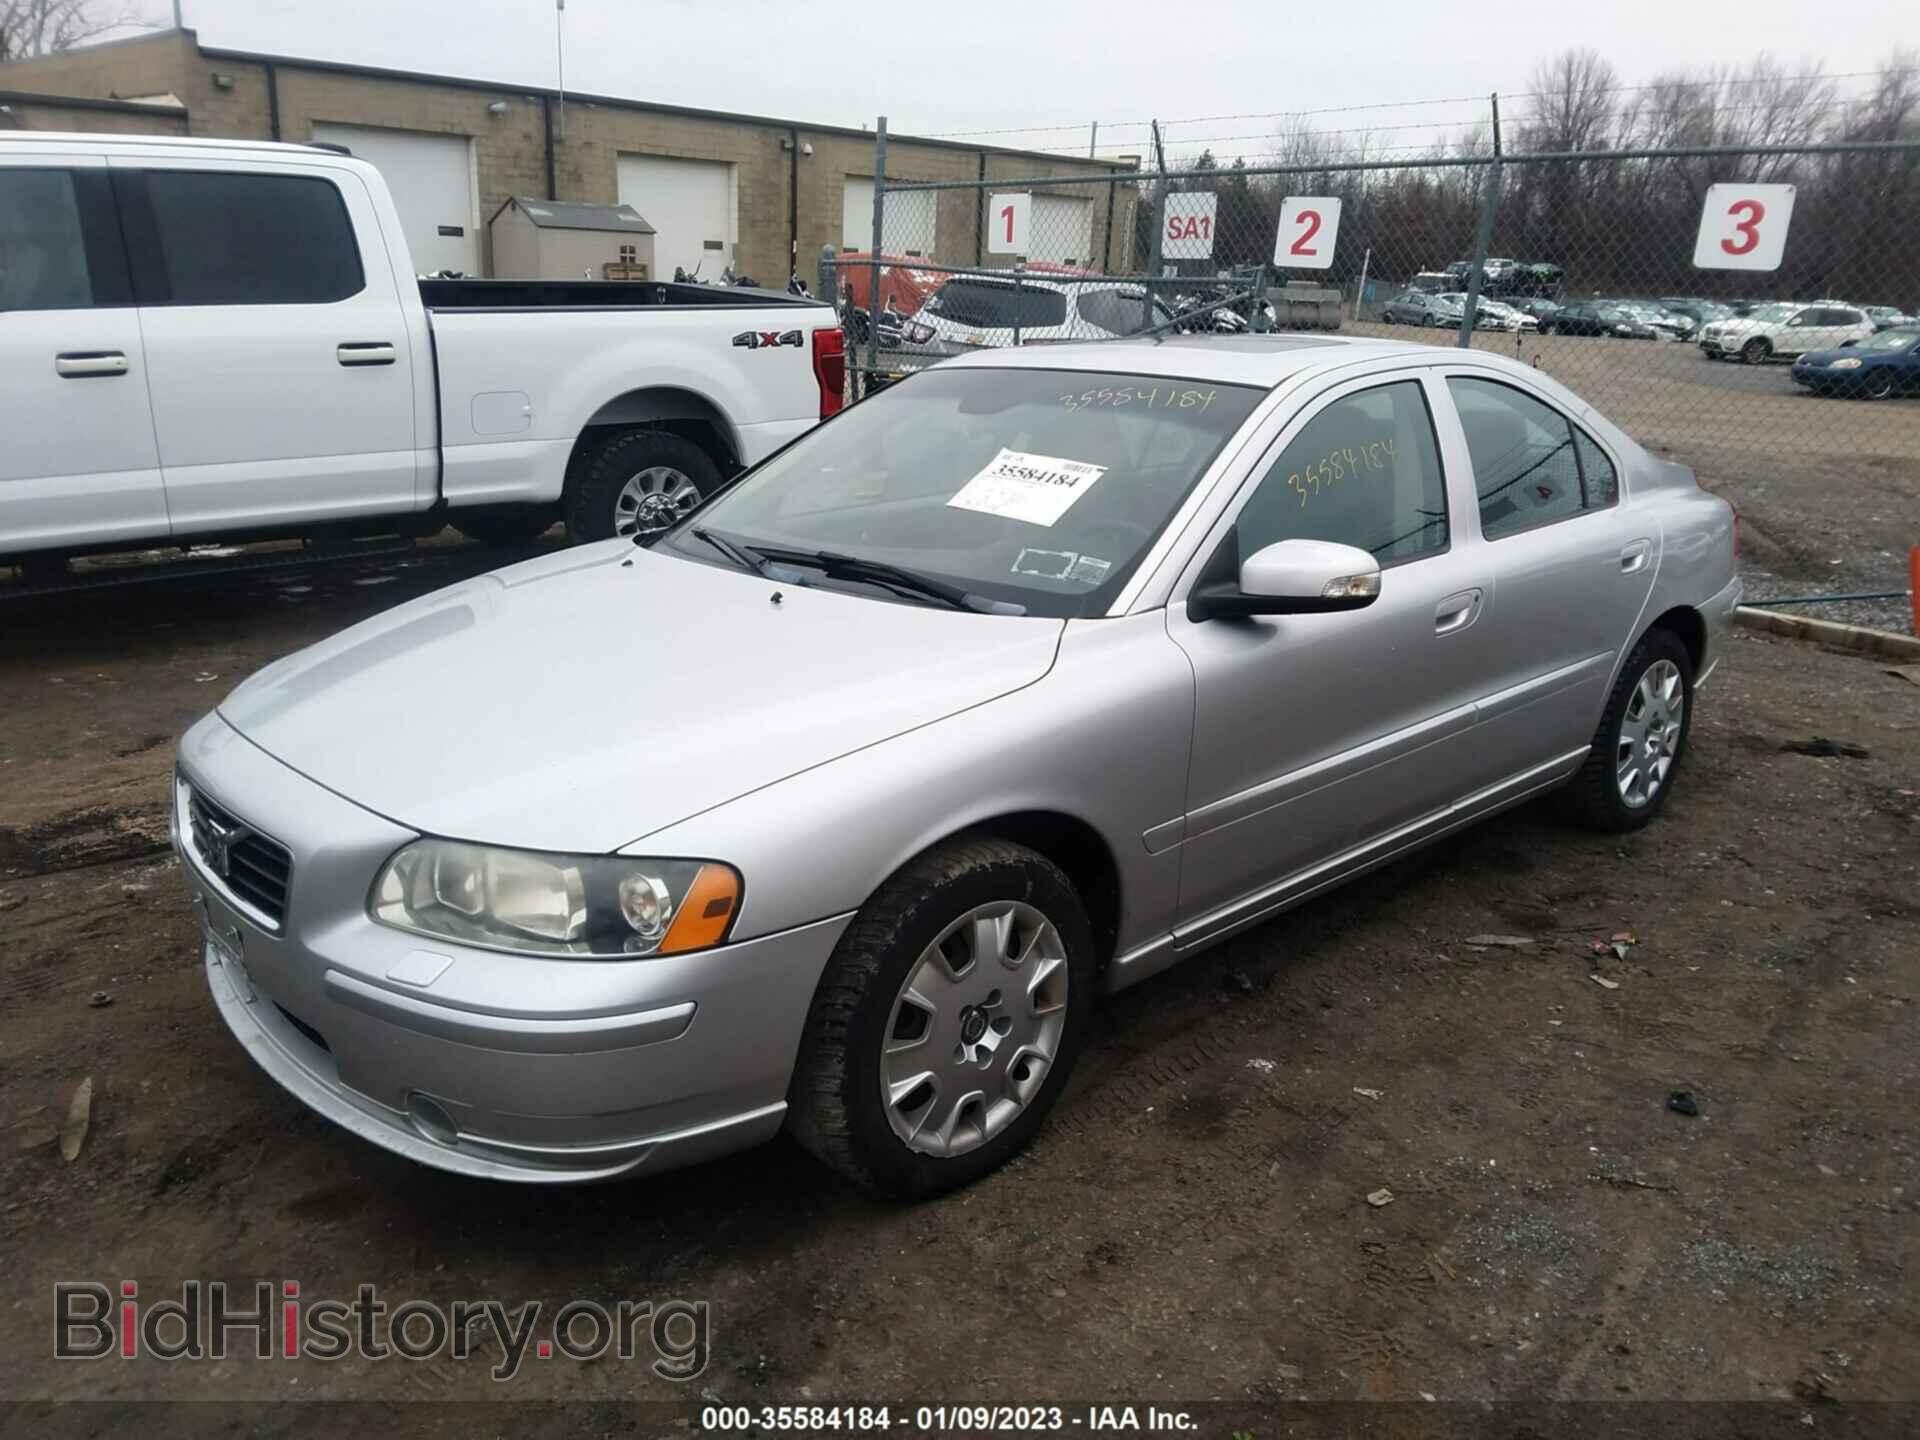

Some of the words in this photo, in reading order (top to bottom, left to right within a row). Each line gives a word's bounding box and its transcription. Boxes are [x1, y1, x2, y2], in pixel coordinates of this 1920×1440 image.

[1000, 205, 1015, 243] 1
[1167, 216, 1212, 240] SA1
[1290, 210, 1322, 255] 2
[1720, 199, 1766, 255] 3
[1059, 387, 1216, 412] 35584184
[992, 464, 1080, 488] 35584184
[1288, 438, 1397, 507] 35584184
